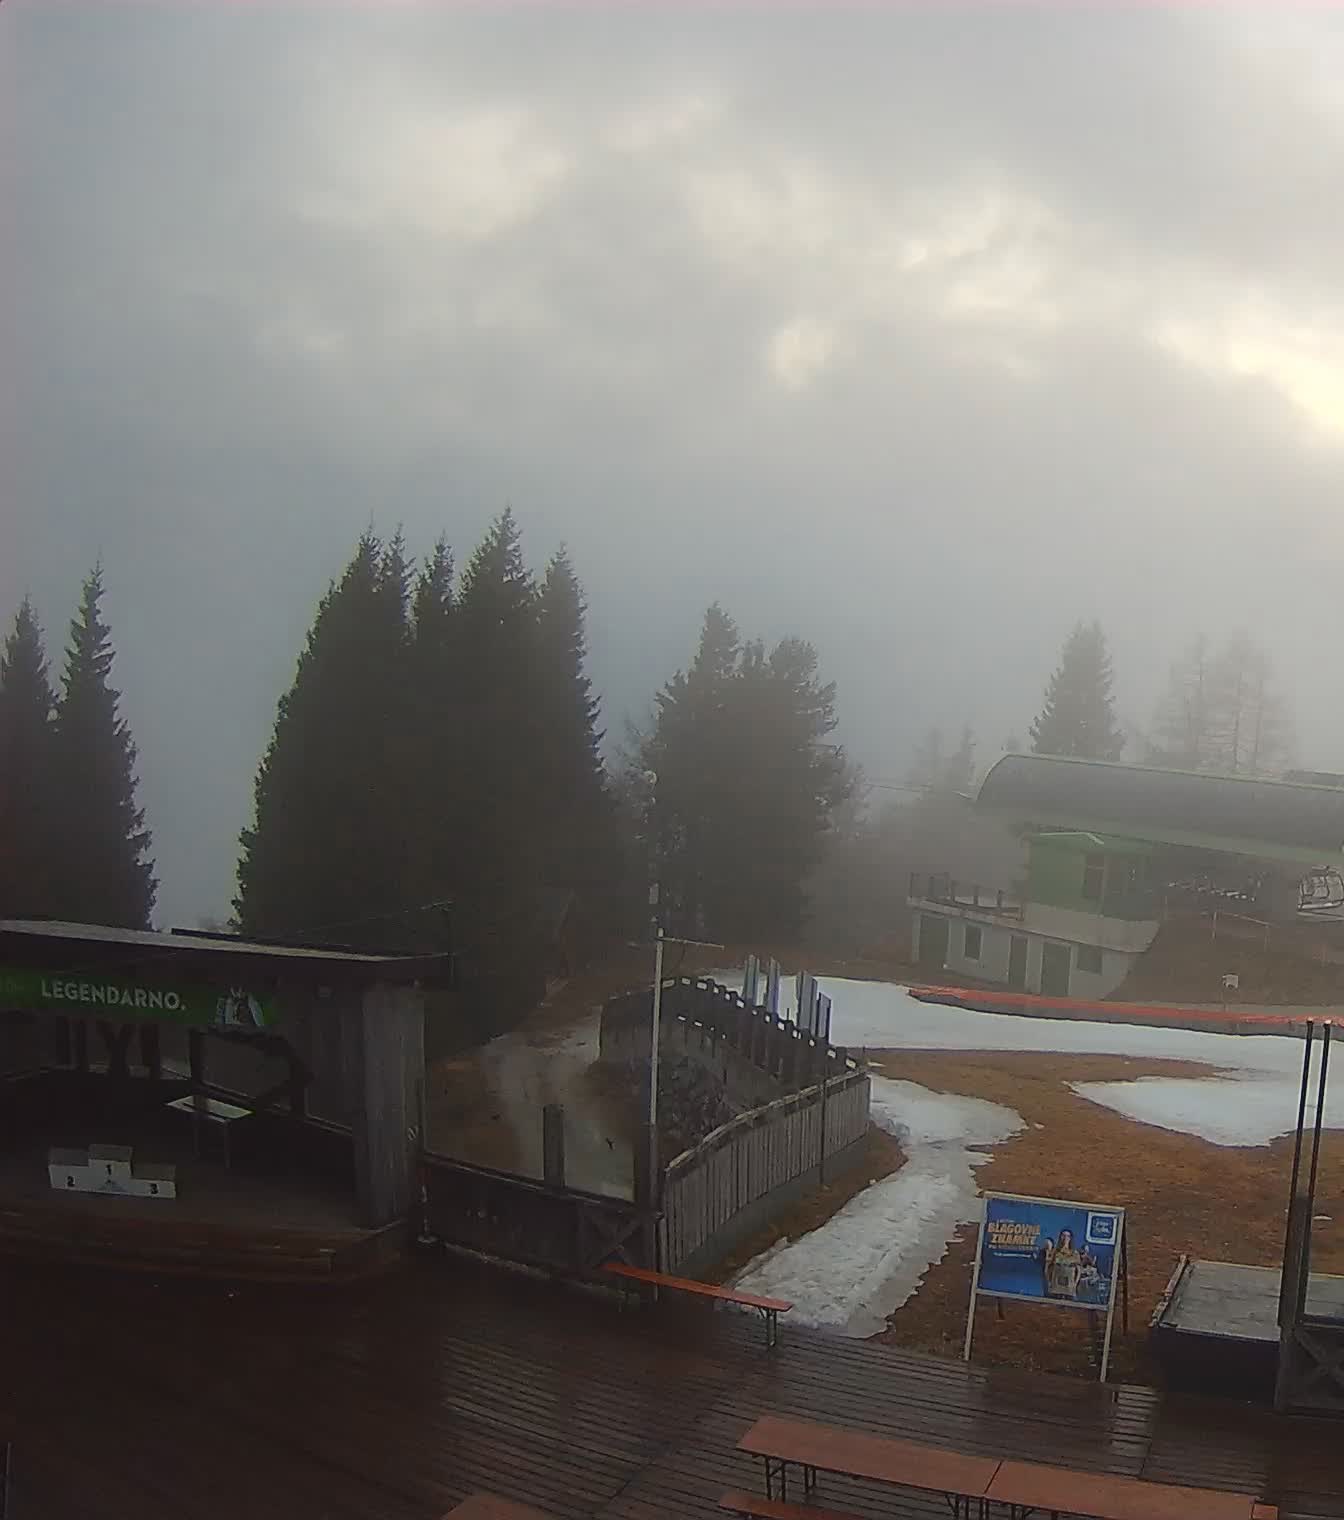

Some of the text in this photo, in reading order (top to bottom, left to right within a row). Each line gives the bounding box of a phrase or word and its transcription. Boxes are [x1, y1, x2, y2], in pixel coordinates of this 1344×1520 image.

[41, 979, 187, 1011] LEGENDARNO.
[105, 1164, 112, 1176] 1
[67, 1175, 76, 1188] 2
[150, 1183, 159, 1195] 3
